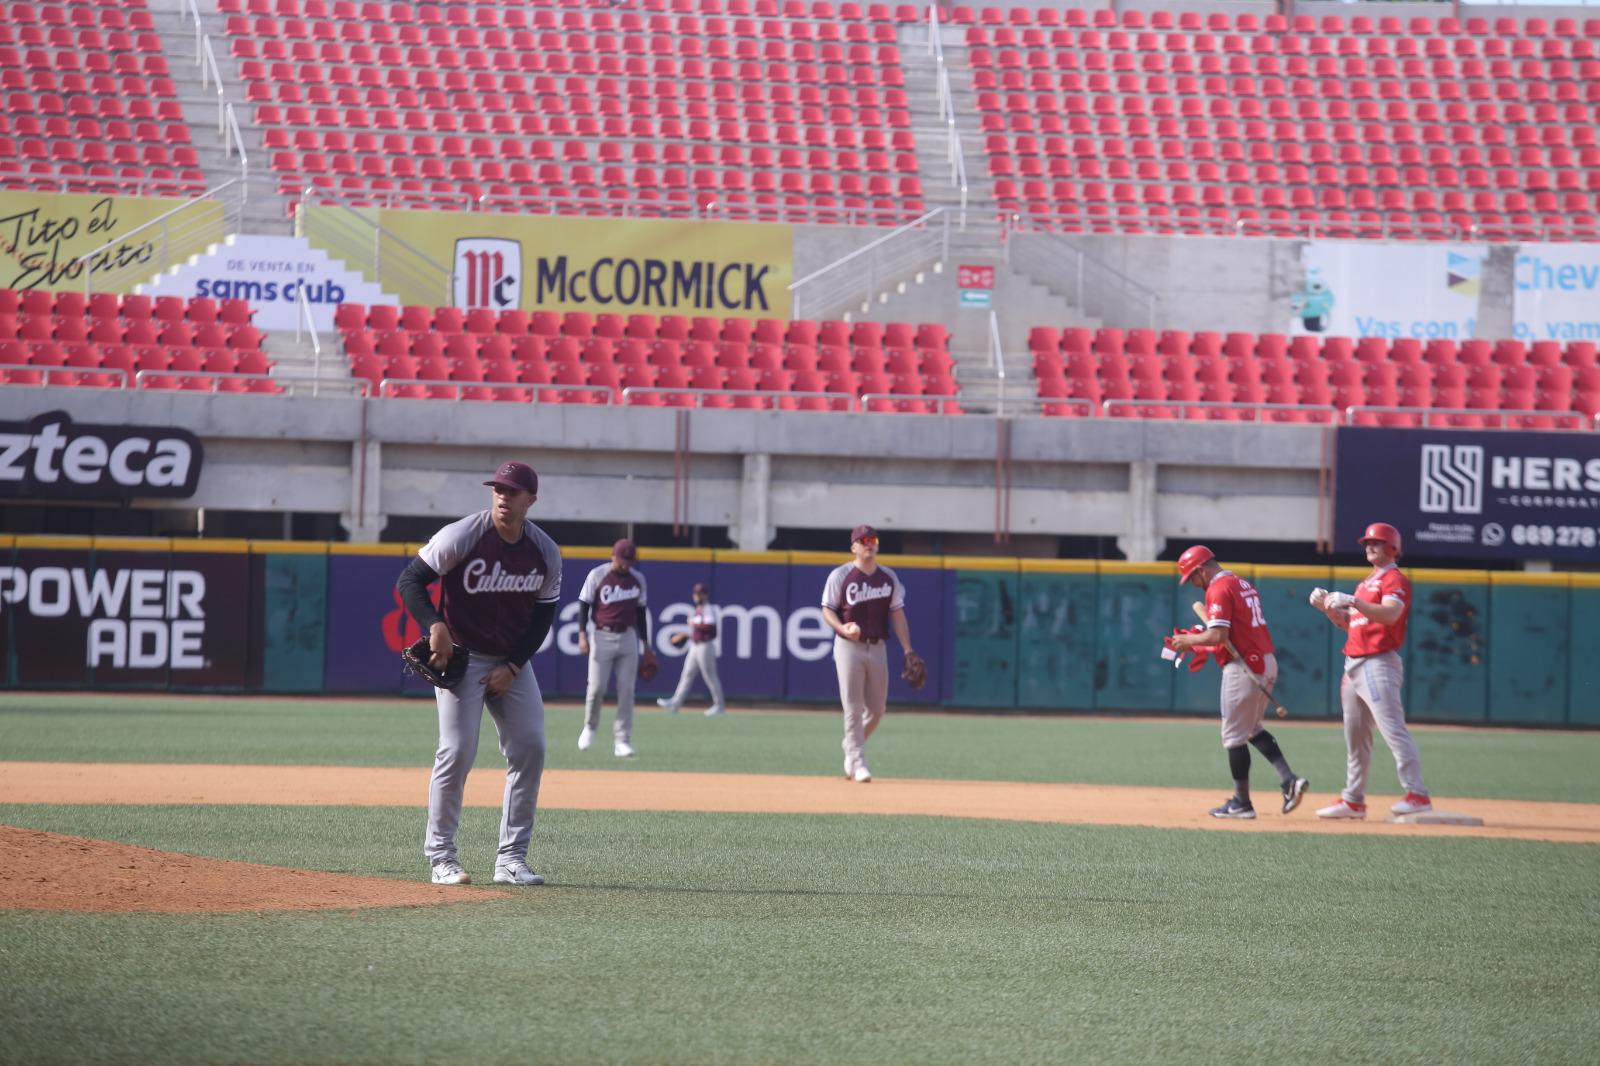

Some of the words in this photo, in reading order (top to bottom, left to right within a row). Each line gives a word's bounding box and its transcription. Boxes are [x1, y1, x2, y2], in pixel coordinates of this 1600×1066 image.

[0, 206, 79, 254] Tito
[88, 197, 118, 234] el
[9, 238, 155, 295] Eloito
[226, 259, 246, 272] DE
[250, 260, 293, 273] VENTA
[296, 261, 315, 274] EN
[536, 255, 770, 311] McCORMICK
[1515, 254, 1600, 292] Chev
[195, 278, 278, 302] sams
[1355, 315, 1401, 339] Vas
[1410, 319, 1458, 339] con
[0, 422, 192, 487] zteca
[1491, 456, 1600, 493] HERS
[0, 566, 206, 619] POWER
[463, 558, 545, 595] Culiacán
[86, 618, 206, 669] ADE
